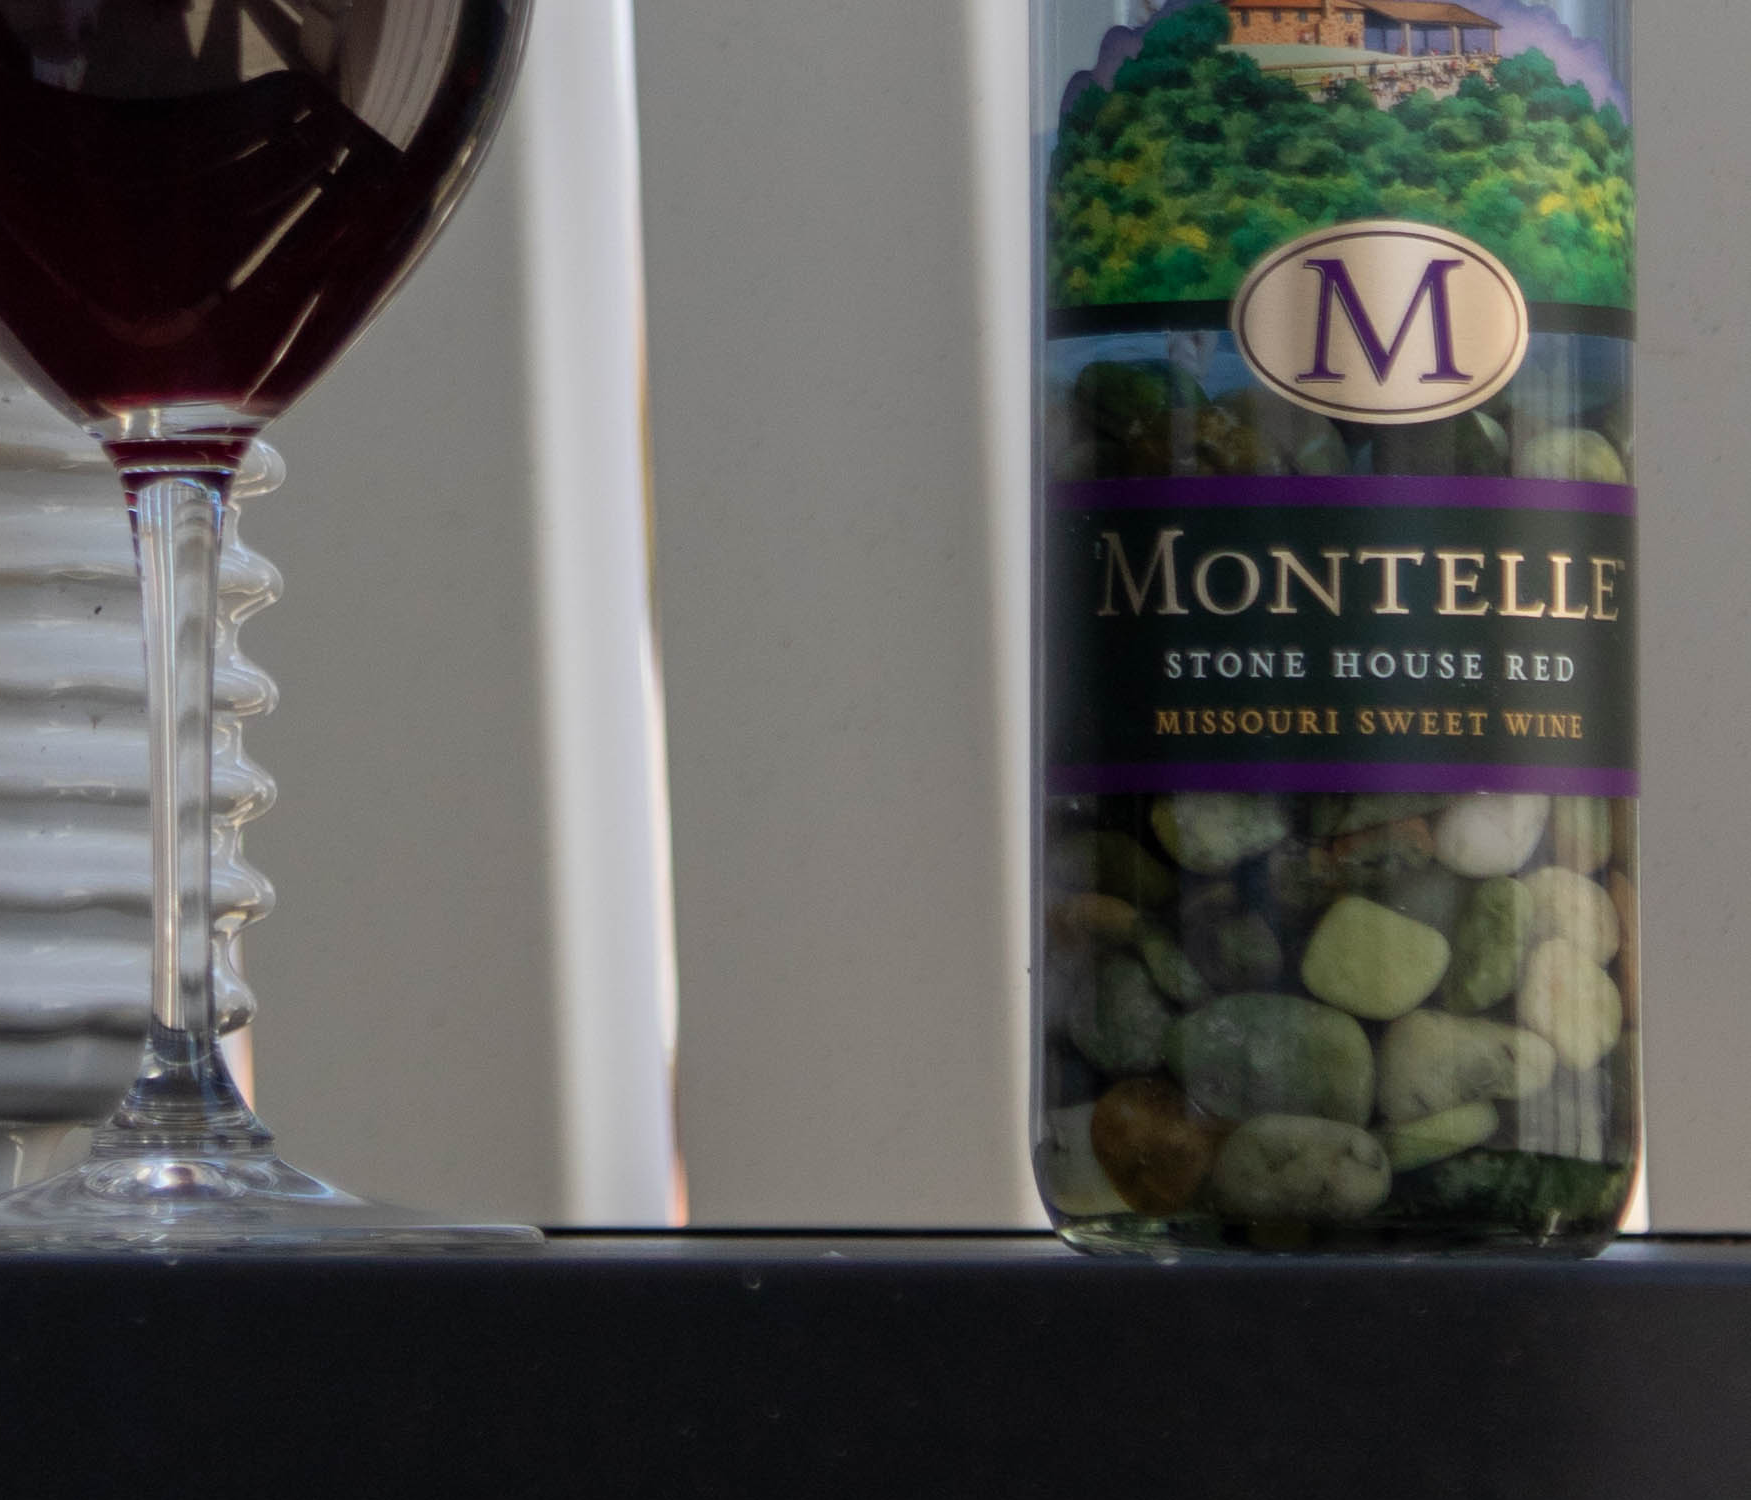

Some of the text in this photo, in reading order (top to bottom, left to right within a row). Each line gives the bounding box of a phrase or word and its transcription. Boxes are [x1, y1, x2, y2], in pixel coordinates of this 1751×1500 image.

[1296, 258, 1474, 386] M
[1097, 527, 1619, 622] MONTELLE
[1166, 651, 1576, 684] STONE HOUSE RED
[1155, 709, 1584, 741] MISSOURI SWEET WINE
